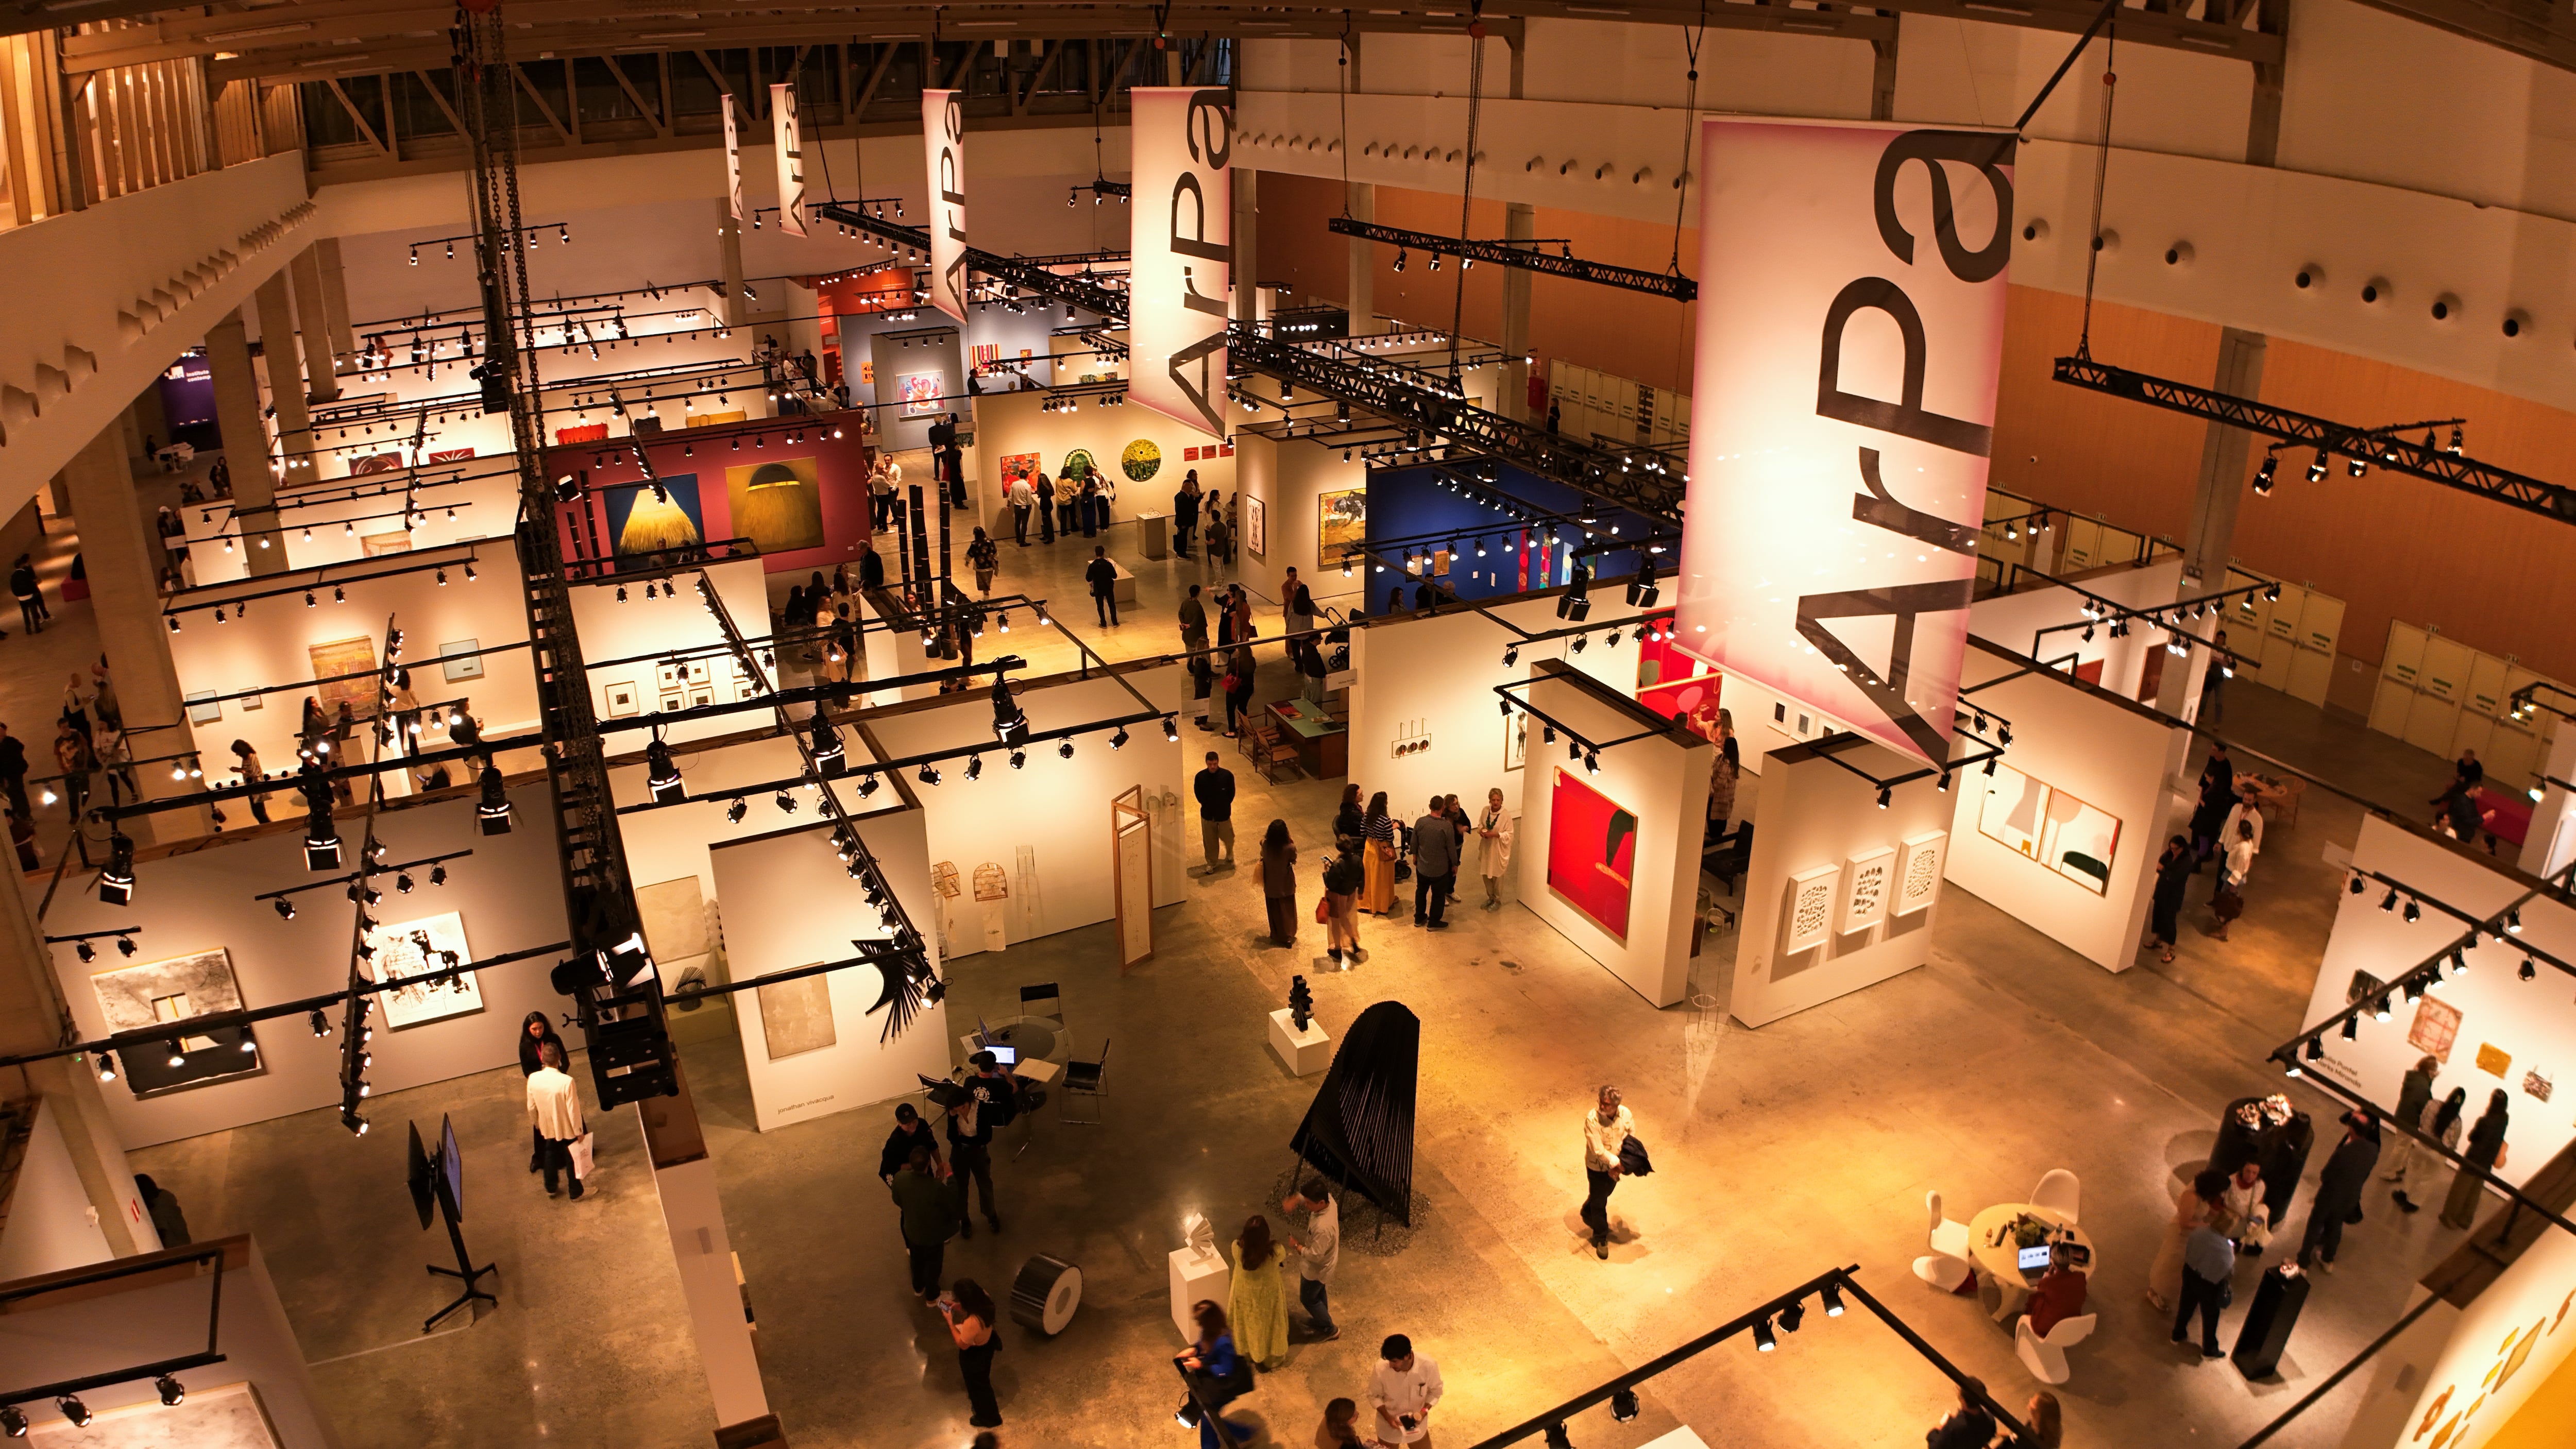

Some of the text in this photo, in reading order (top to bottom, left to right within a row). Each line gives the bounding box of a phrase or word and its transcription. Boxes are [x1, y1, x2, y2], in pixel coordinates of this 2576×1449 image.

[785, 85, 808, 238] ArPa
[941, 92, 968, 327] ArPa
[1168, 89, 1231, 442] ArPa
[1795, 128, 2020, 774] ArPa
[777, 1095, 834, 1115] jonathan vivacqua
